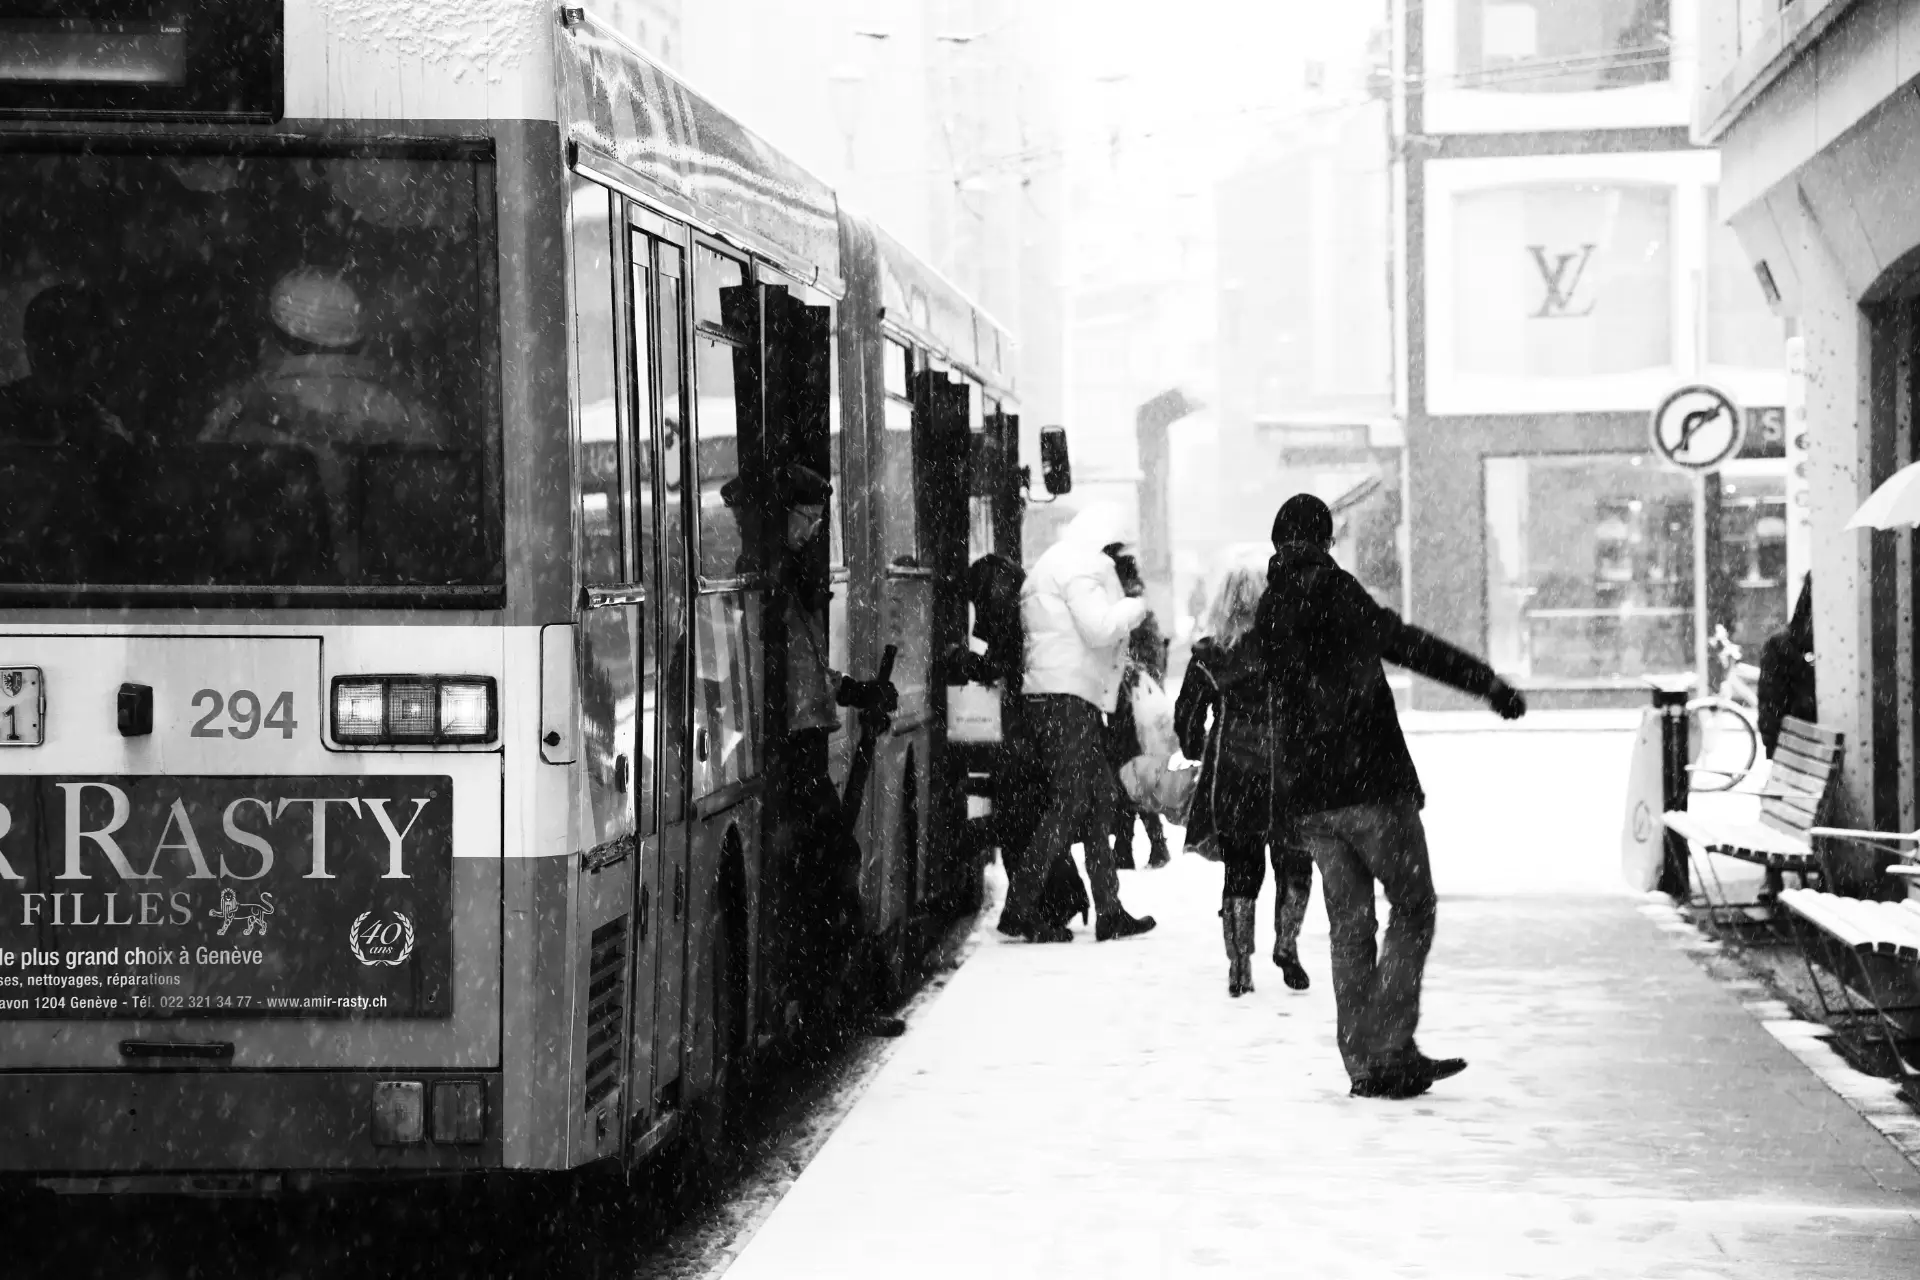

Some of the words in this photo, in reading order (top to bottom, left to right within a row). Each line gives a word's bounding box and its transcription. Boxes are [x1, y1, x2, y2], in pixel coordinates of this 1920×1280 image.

[190, 689, 298, 740] 294
[55, 782, 431, 880] RASTY
[20, 892, 192, 926] FILLES
[360, 920, 402, 945] 40
[21, 948, 60, 970] plus
[65, 947, 119, 970] grand
[124, 946, 173, 966] choix
[179, 945, 190, 965] à
[196, 946, 263, 965] Genève
[369, 946, 393, 954] ans
[27, 974, 103, 989] nettoyages,
[106, 972, 181, 988] réparations
[35, 996, 66, 1009] 1204
[70, 995, 118, 1009] Genève
[131, 995, 155, 1009] Tél.
[160, 995, 184, 1008] 022
[188, 995, 210, 1008] 321
[216, 995, 232, 1008] 34
[236, 995, 252, 1008] 77
[266, 995, 387, 1010] www.amir-rasty.ch
